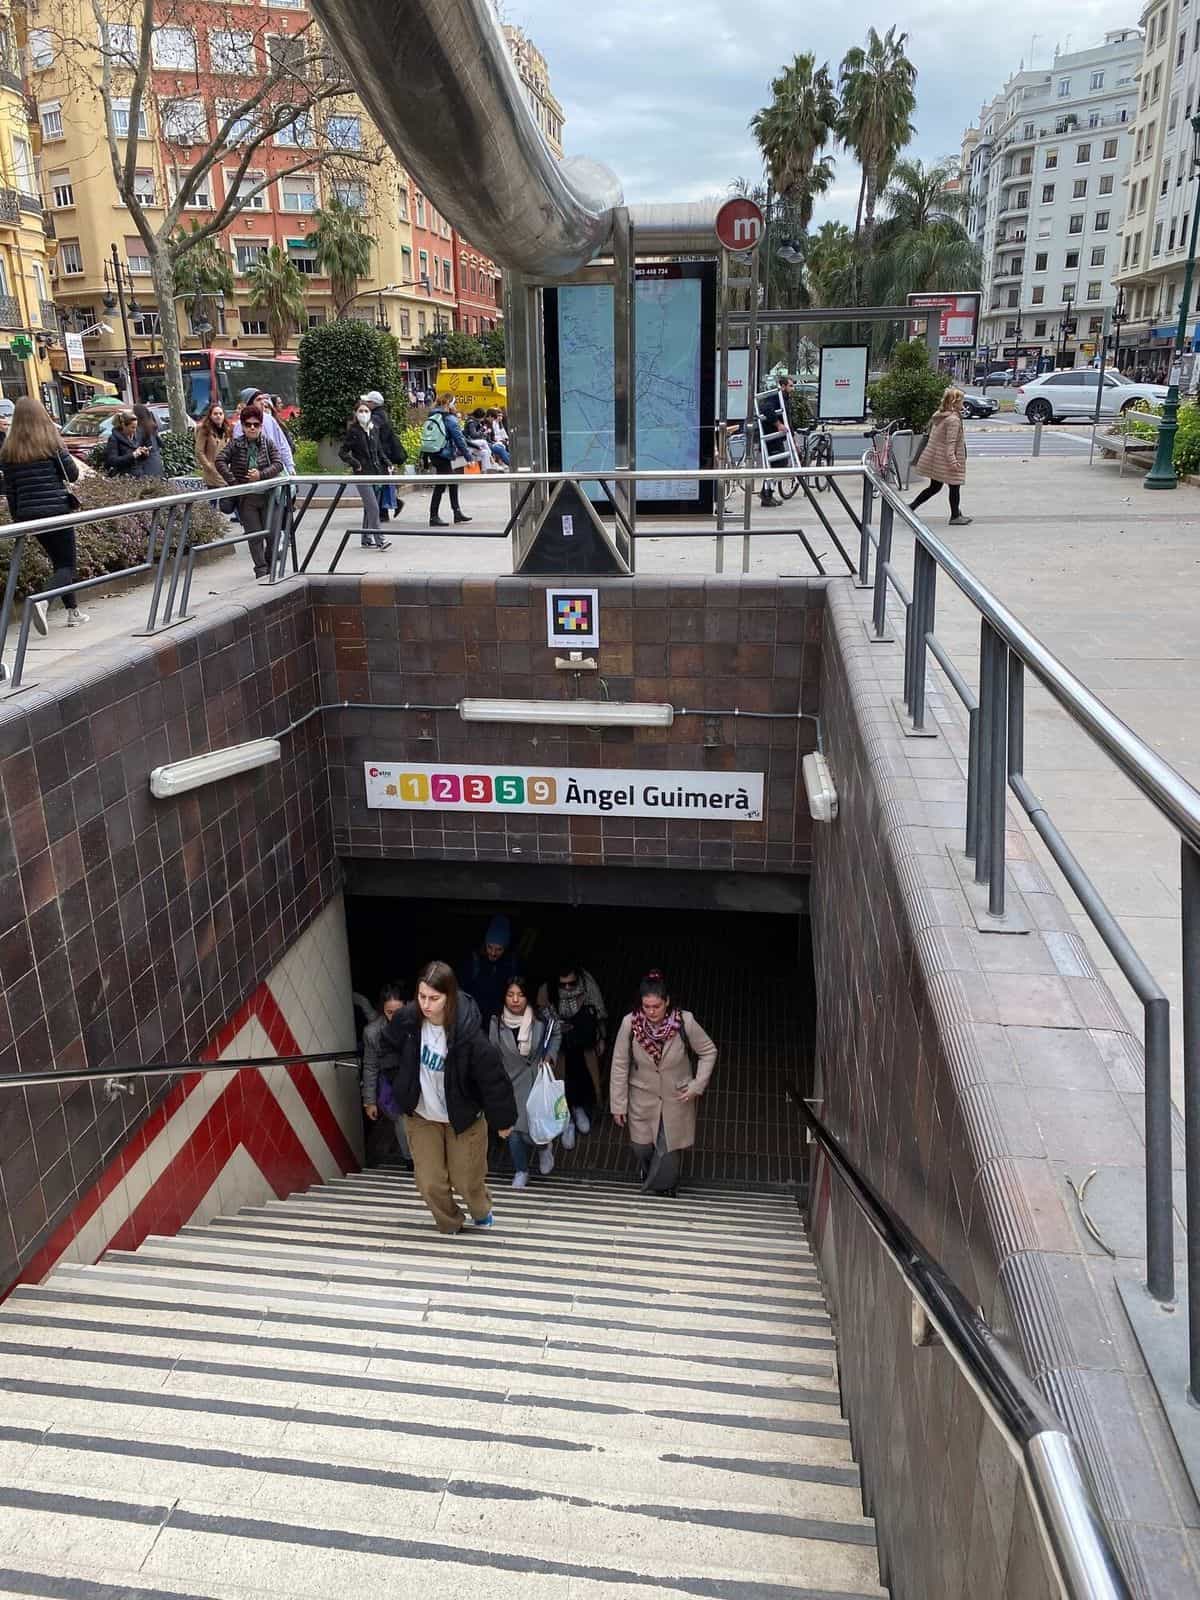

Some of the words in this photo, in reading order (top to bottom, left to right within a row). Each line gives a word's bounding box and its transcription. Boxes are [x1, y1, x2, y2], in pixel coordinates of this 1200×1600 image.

[734, 217, 761, 241] m
[408, 778, 420, 798] 1
[438, 778, 453, 799] 2
[470, 779, 485, 800] 3
[502, 780, 517, 801] 5
[534, 781, 550, 802] 9
[565, 777, 635, 811] Àngel
[643, 786, 749, 810] Guimerà
